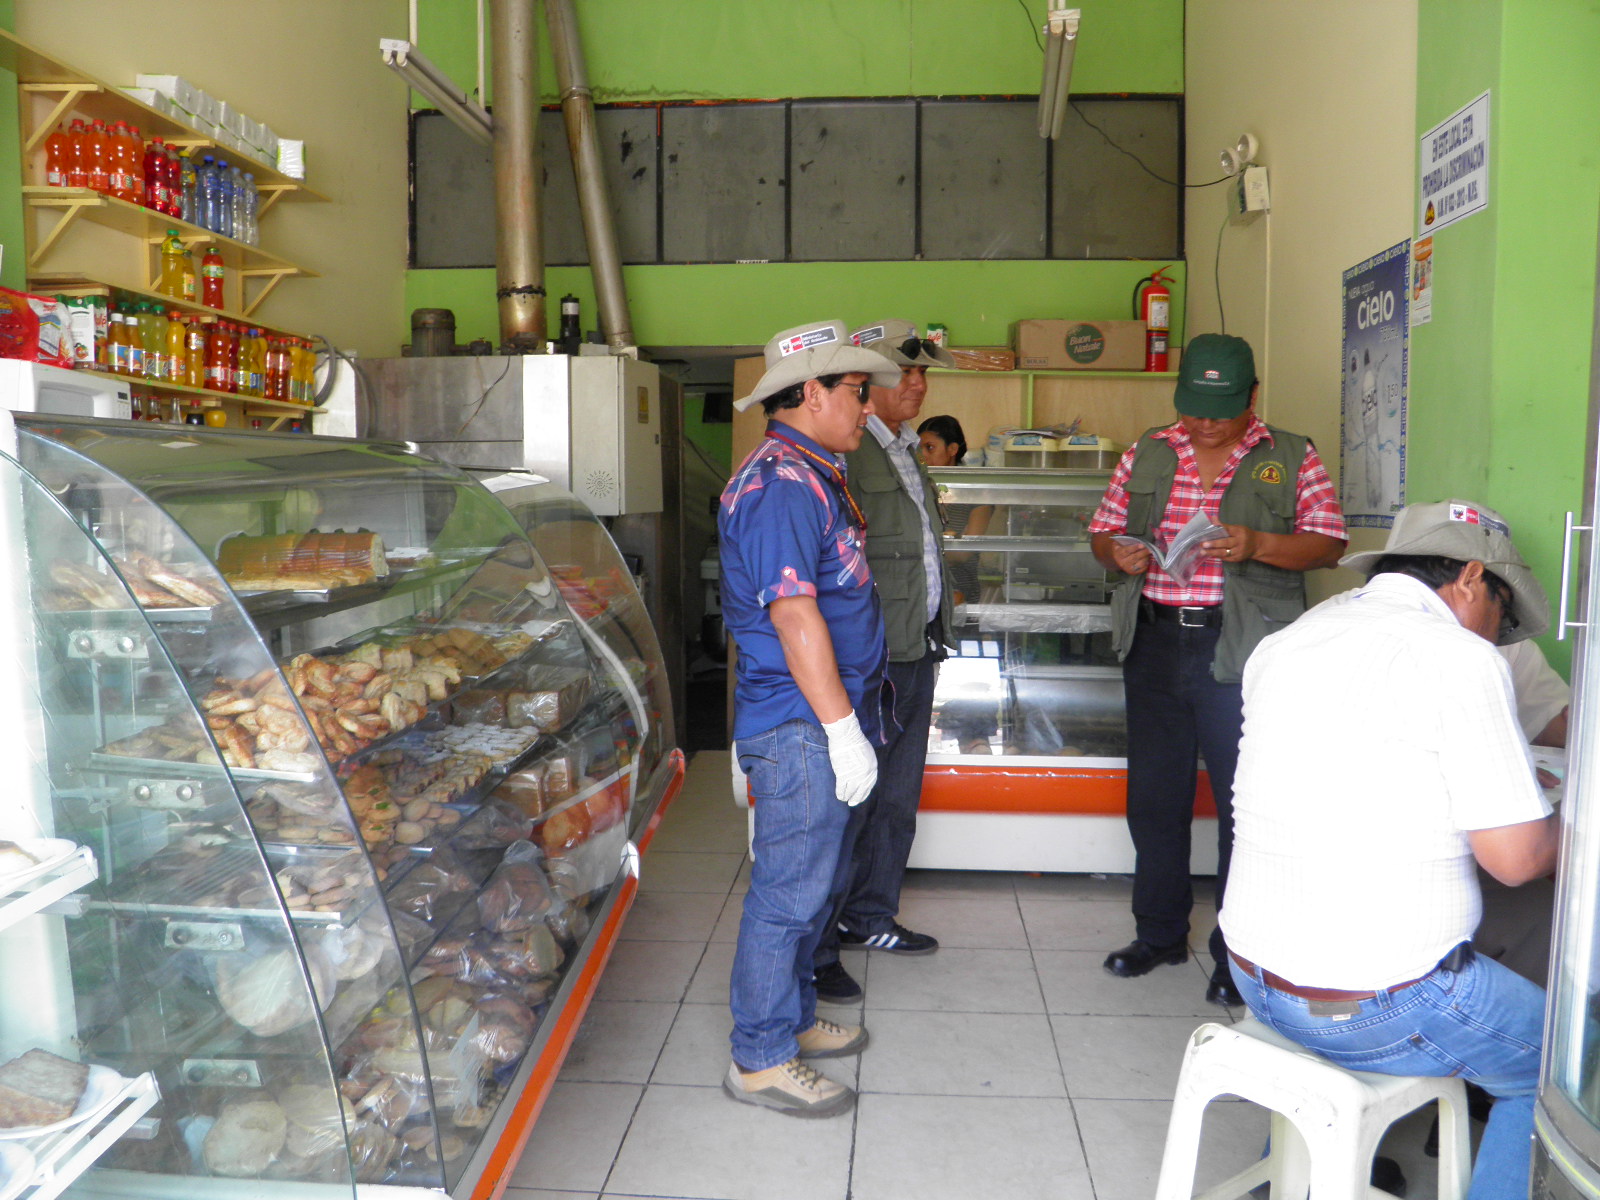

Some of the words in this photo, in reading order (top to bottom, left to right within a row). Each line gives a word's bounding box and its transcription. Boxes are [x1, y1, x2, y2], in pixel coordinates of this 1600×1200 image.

[1438, 129, 1449, 159] ESTE
[1449, 121, 1462, 153] LOCAL
[1422, 166, 1443, 199] PROHIBIDA
[1357, 290, 1394, 330] cielo
